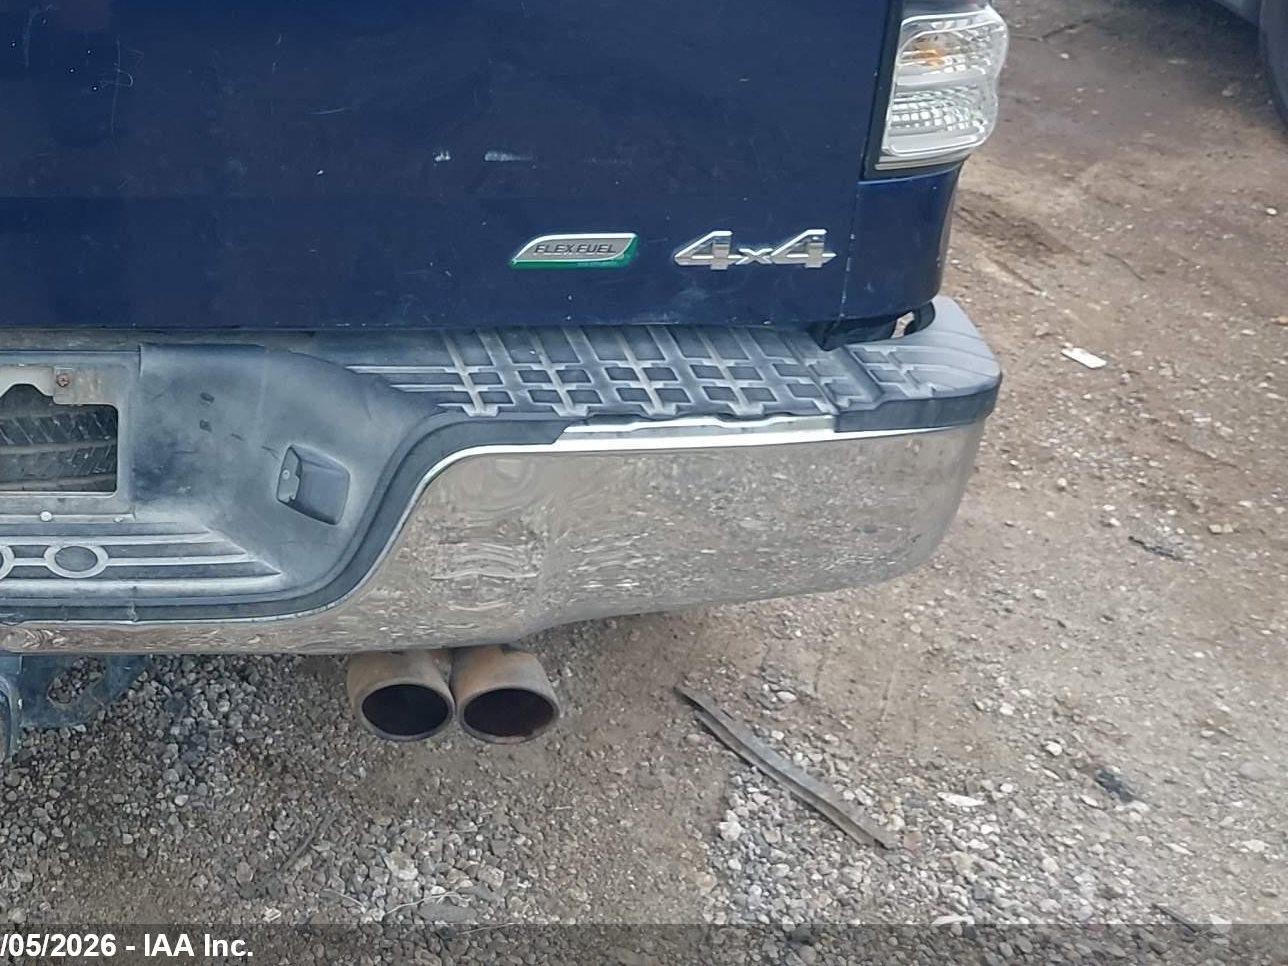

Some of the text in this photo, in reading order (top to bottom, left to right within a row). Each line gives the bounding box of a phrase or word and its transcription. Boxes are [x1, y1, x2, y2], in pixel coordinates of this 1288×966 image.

[533, 242, 617, 255] FLEX FUEL
[672, 229, 838, 271] 4x4
